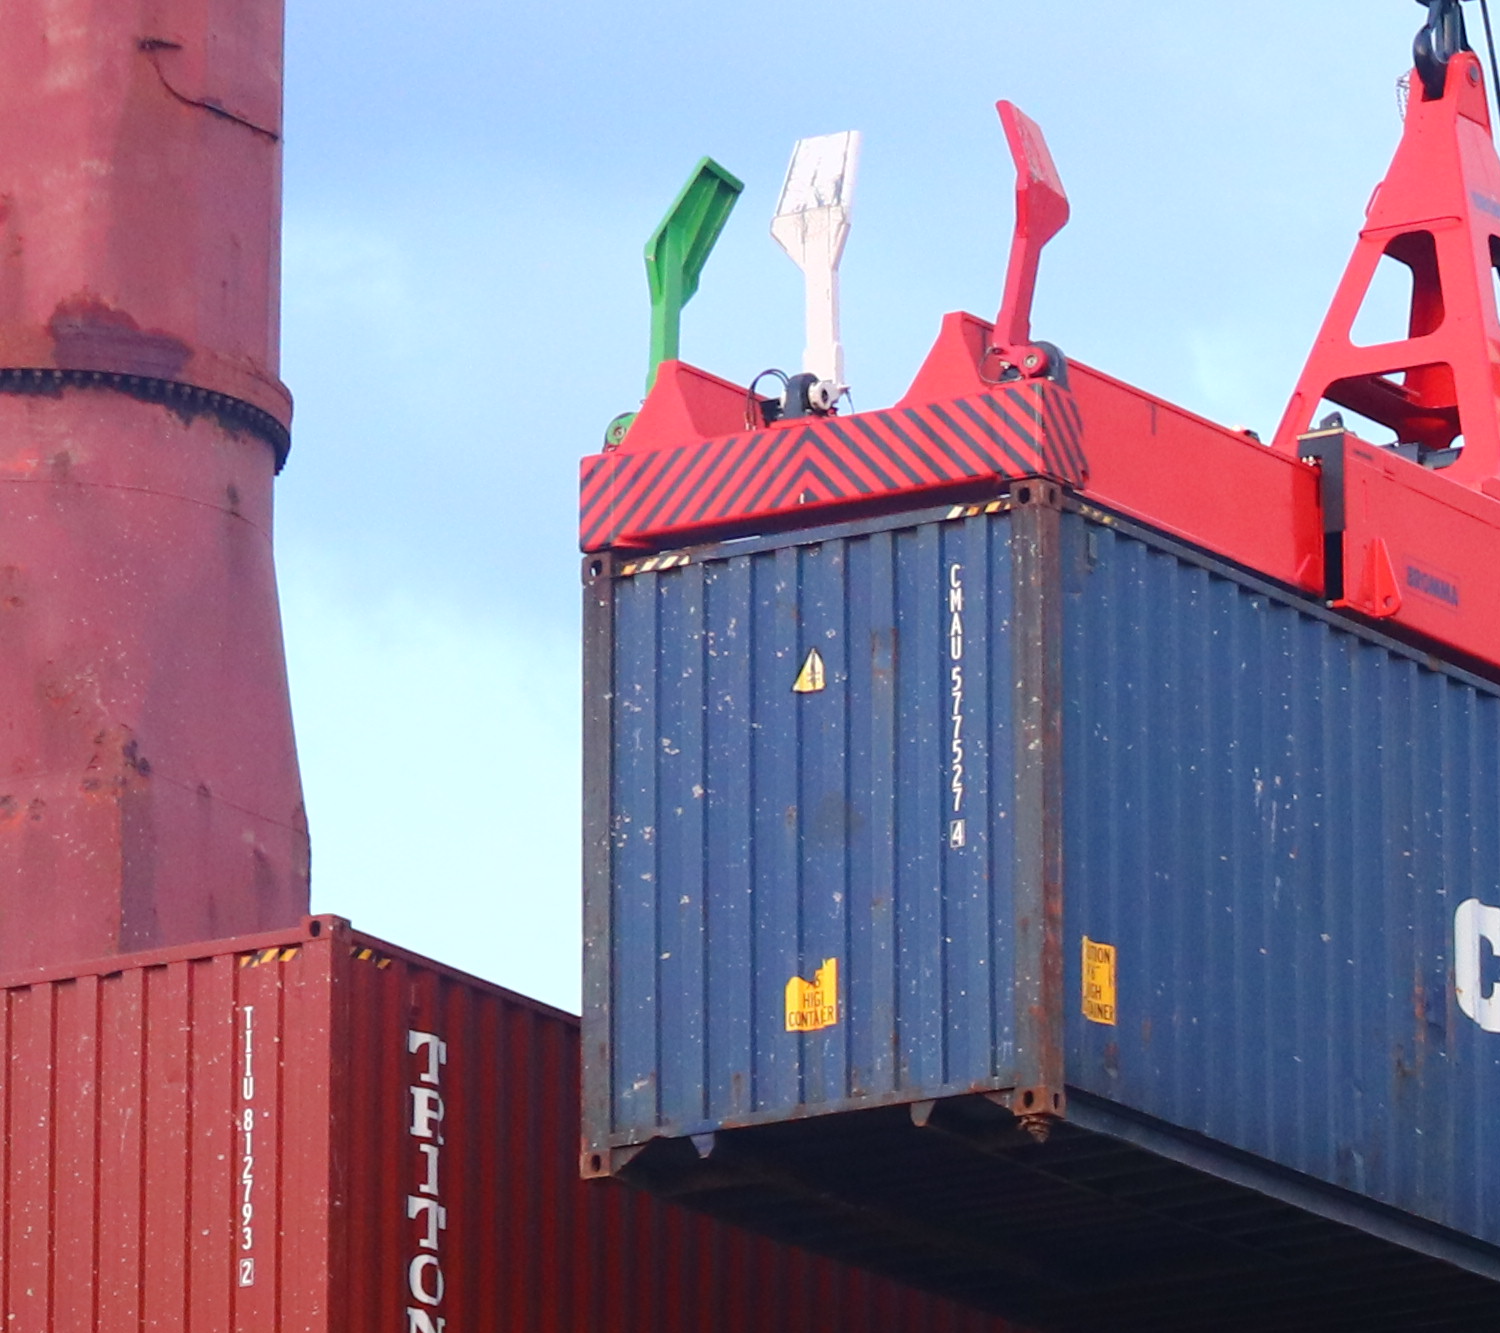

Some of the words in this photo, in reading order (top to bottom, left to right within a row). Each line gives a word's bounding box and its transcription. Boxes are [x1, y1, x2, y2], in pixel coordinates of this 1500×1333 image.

[949, 564, 963, 659] CMAU
[950, 666, 964, 812] 577527
[950, 819, 965, 848] 4
[241, 1005, 255, 1102] TIIU
[240, 1109, 254, 1251] 812793
[239, 1259, 254, 1287] 2
